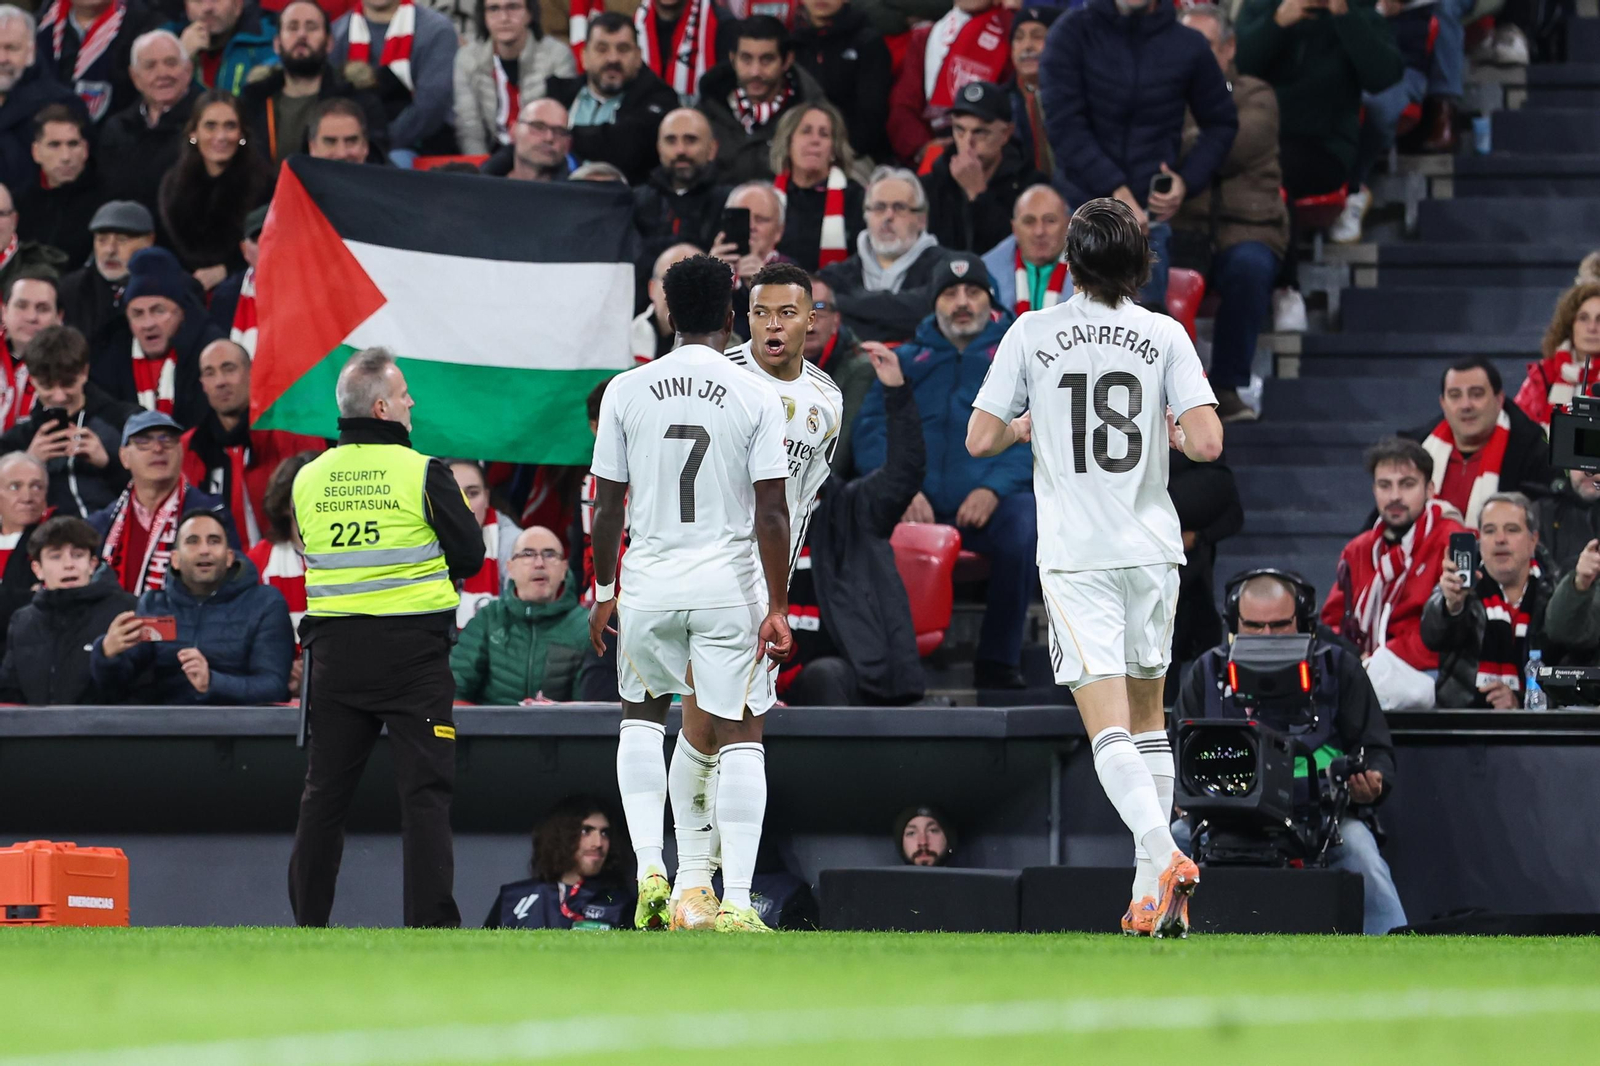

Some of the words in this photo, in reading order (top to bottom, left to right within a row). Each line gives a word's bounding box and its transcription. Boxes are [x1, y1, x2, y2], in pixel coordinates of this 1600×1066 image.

[1035, 349, 1060, 369] A.
[1055, 324, 1159, 365] CARRERAS
[649, 377, 692, 401] VINI
[698, 379, 727, 409] JR.
[1057, 371, 1142, 473] 18
[786, 439, 815, 461] ates
[329, 470, 387, 482] SECURITY
[663, 424, 711, 523] 7
[324, 484, 391, 497] SEGURIDAD
[315, 499, 400, 513] SEGURTASUNA
[329, 521, 380, 547] 225
